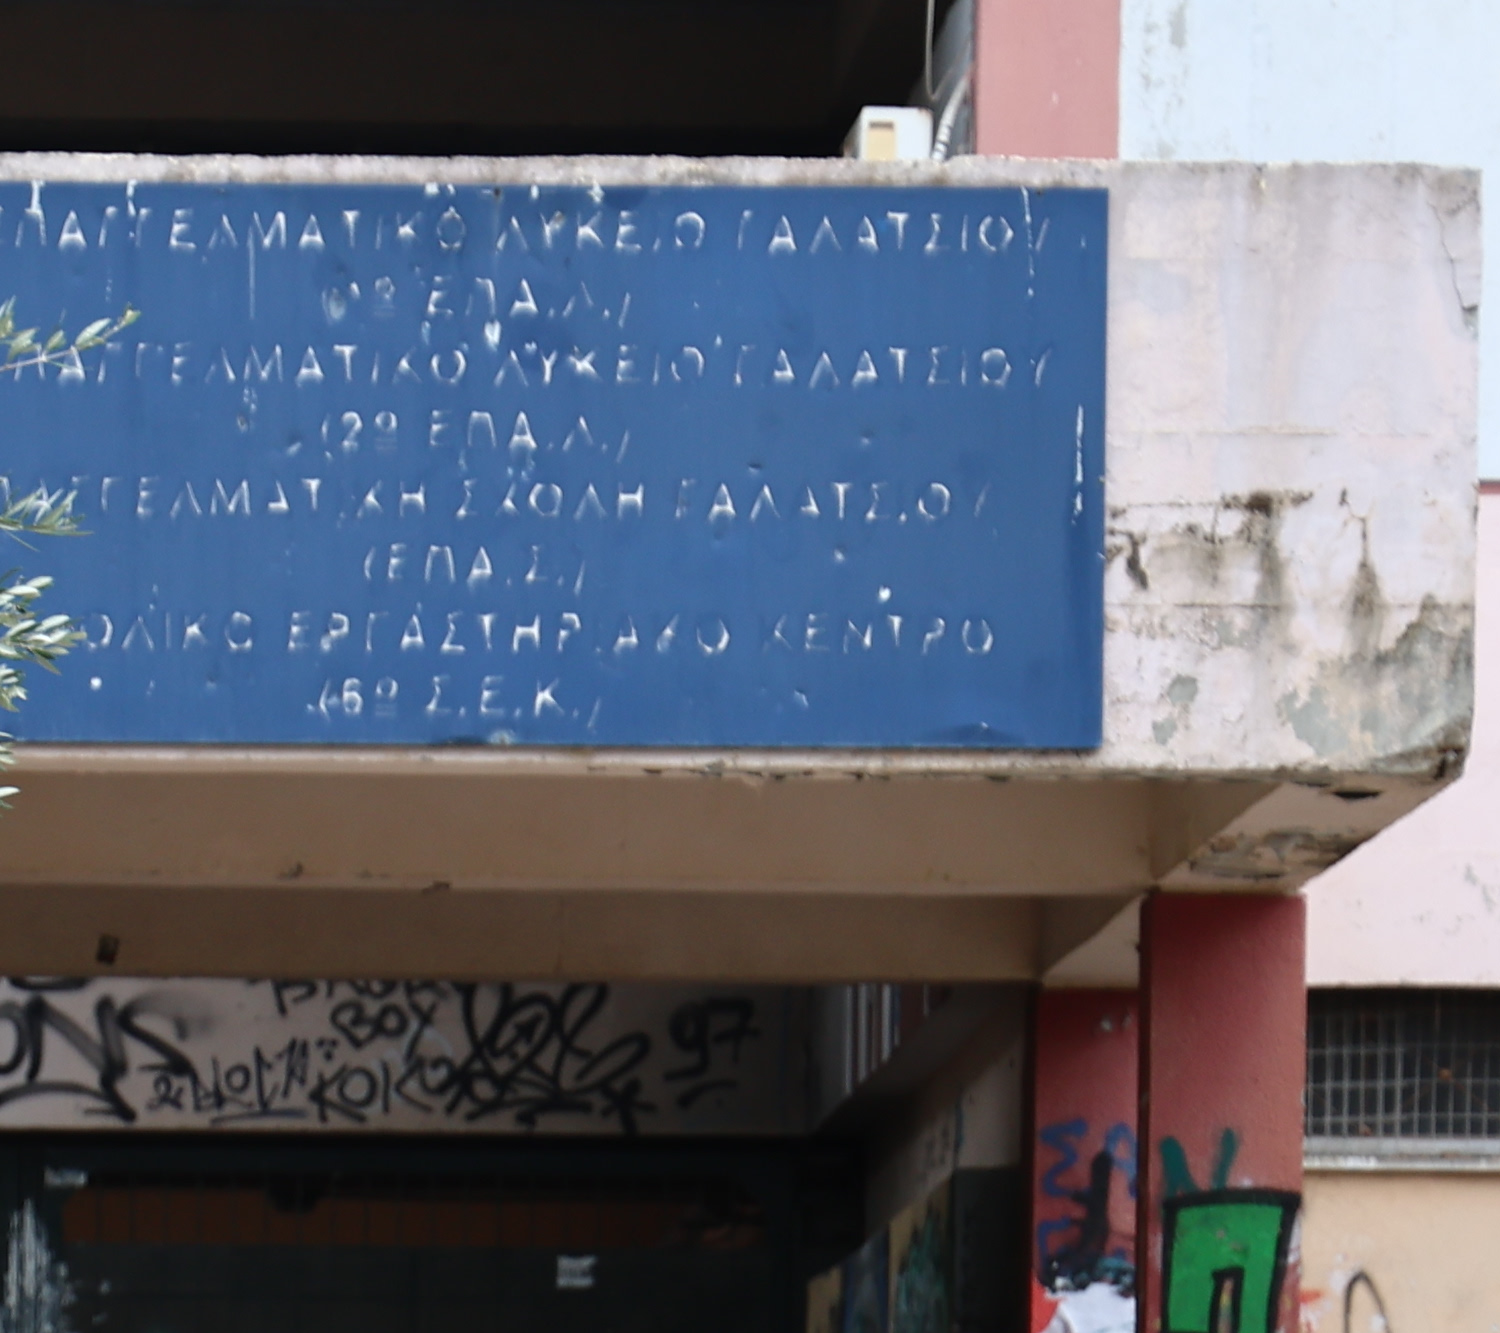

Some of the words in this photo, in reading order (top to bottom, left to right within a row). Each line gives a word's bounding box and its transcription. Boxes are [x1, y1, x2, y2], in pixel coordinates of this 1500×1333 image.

[494, 345, 706, 388] ΛΥΚΕΙΟ
[735, 345, 1054, 390] ΓΑΛΑΤΣΙΟΥ
[70, 609, 253, 653] ΟΛΙΚΟ
[288, 610, 730, 656] ΕΡΓΑΣΤΗΡΑΚΟ
